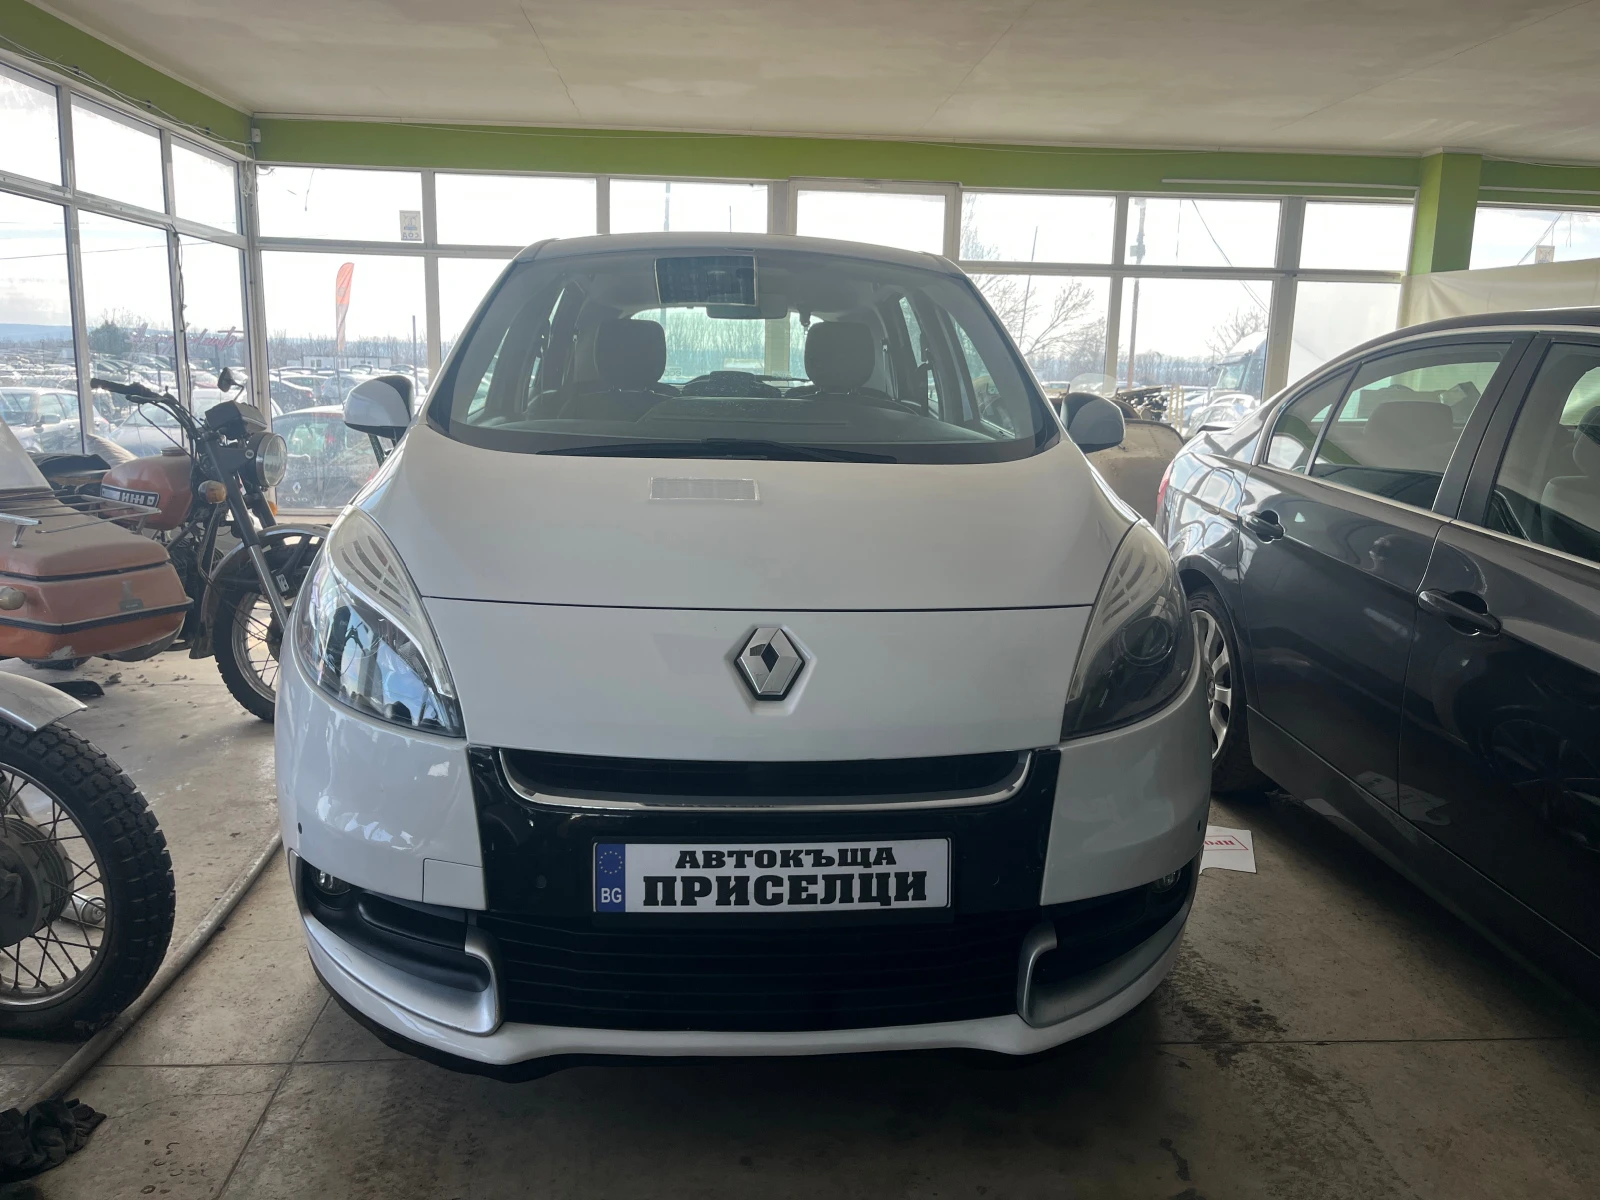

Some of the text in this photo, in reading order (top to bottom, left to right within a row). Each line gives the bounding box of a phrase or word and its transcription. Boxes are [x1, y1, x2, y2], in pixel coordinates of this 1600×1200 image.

[675, 847, 897, 868] АВТОКЪЩА
[600, 887, 623, 904] BG
[643, 871, 928, 906] ПРИСЕЛЦИ
